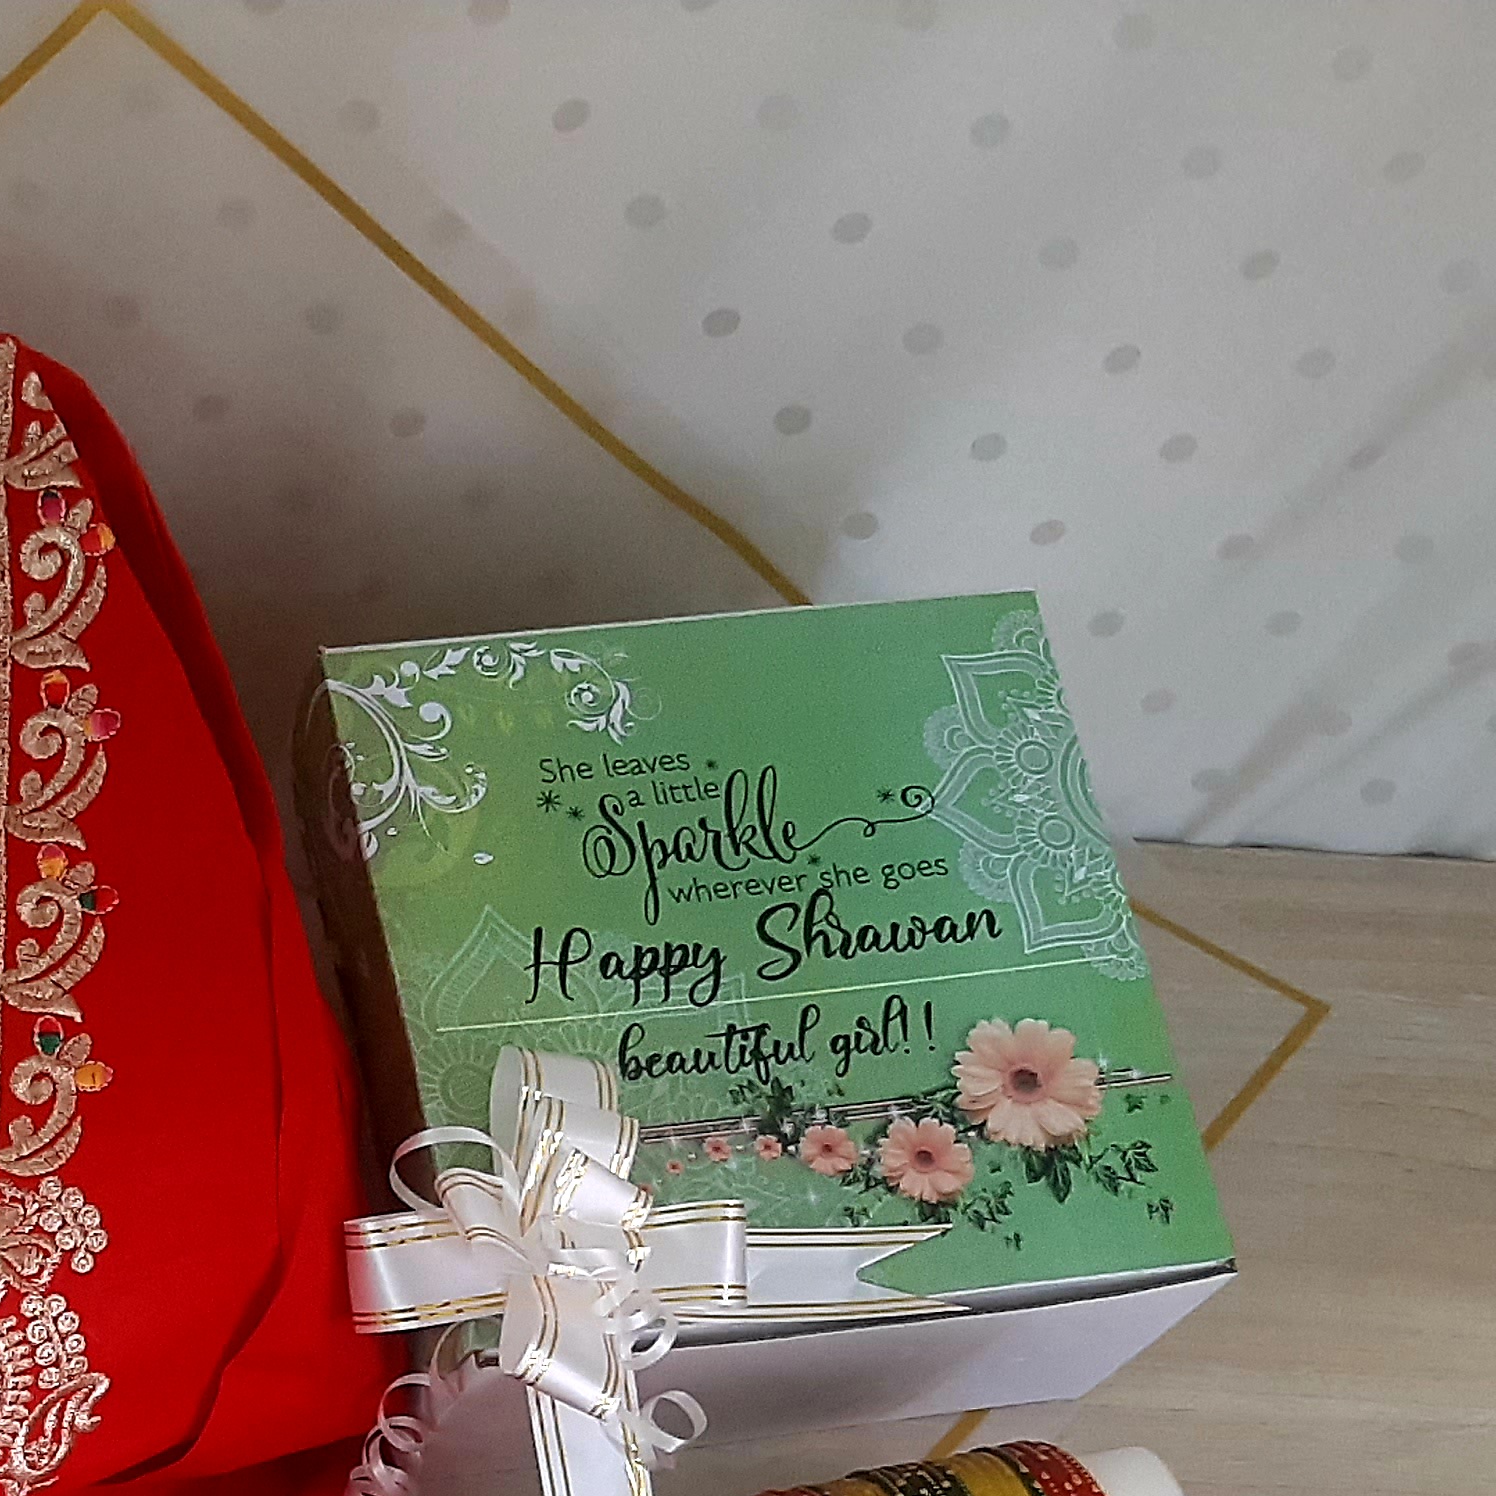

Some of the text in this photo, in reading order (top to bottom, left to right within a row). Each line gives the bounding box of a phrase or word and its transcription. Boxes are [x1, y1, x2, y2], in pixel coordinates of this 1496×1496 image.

[538, 751, 691, 785] She leaves
[626, 777, 721, 809] a little
[582, 765, 816, 926] Sparkle
[666, 854, 951, 904] wherever she goes
[523, 888, 1003, 1008] Happy Shrawan
[617, 1003, 822, 1086] beautiful
